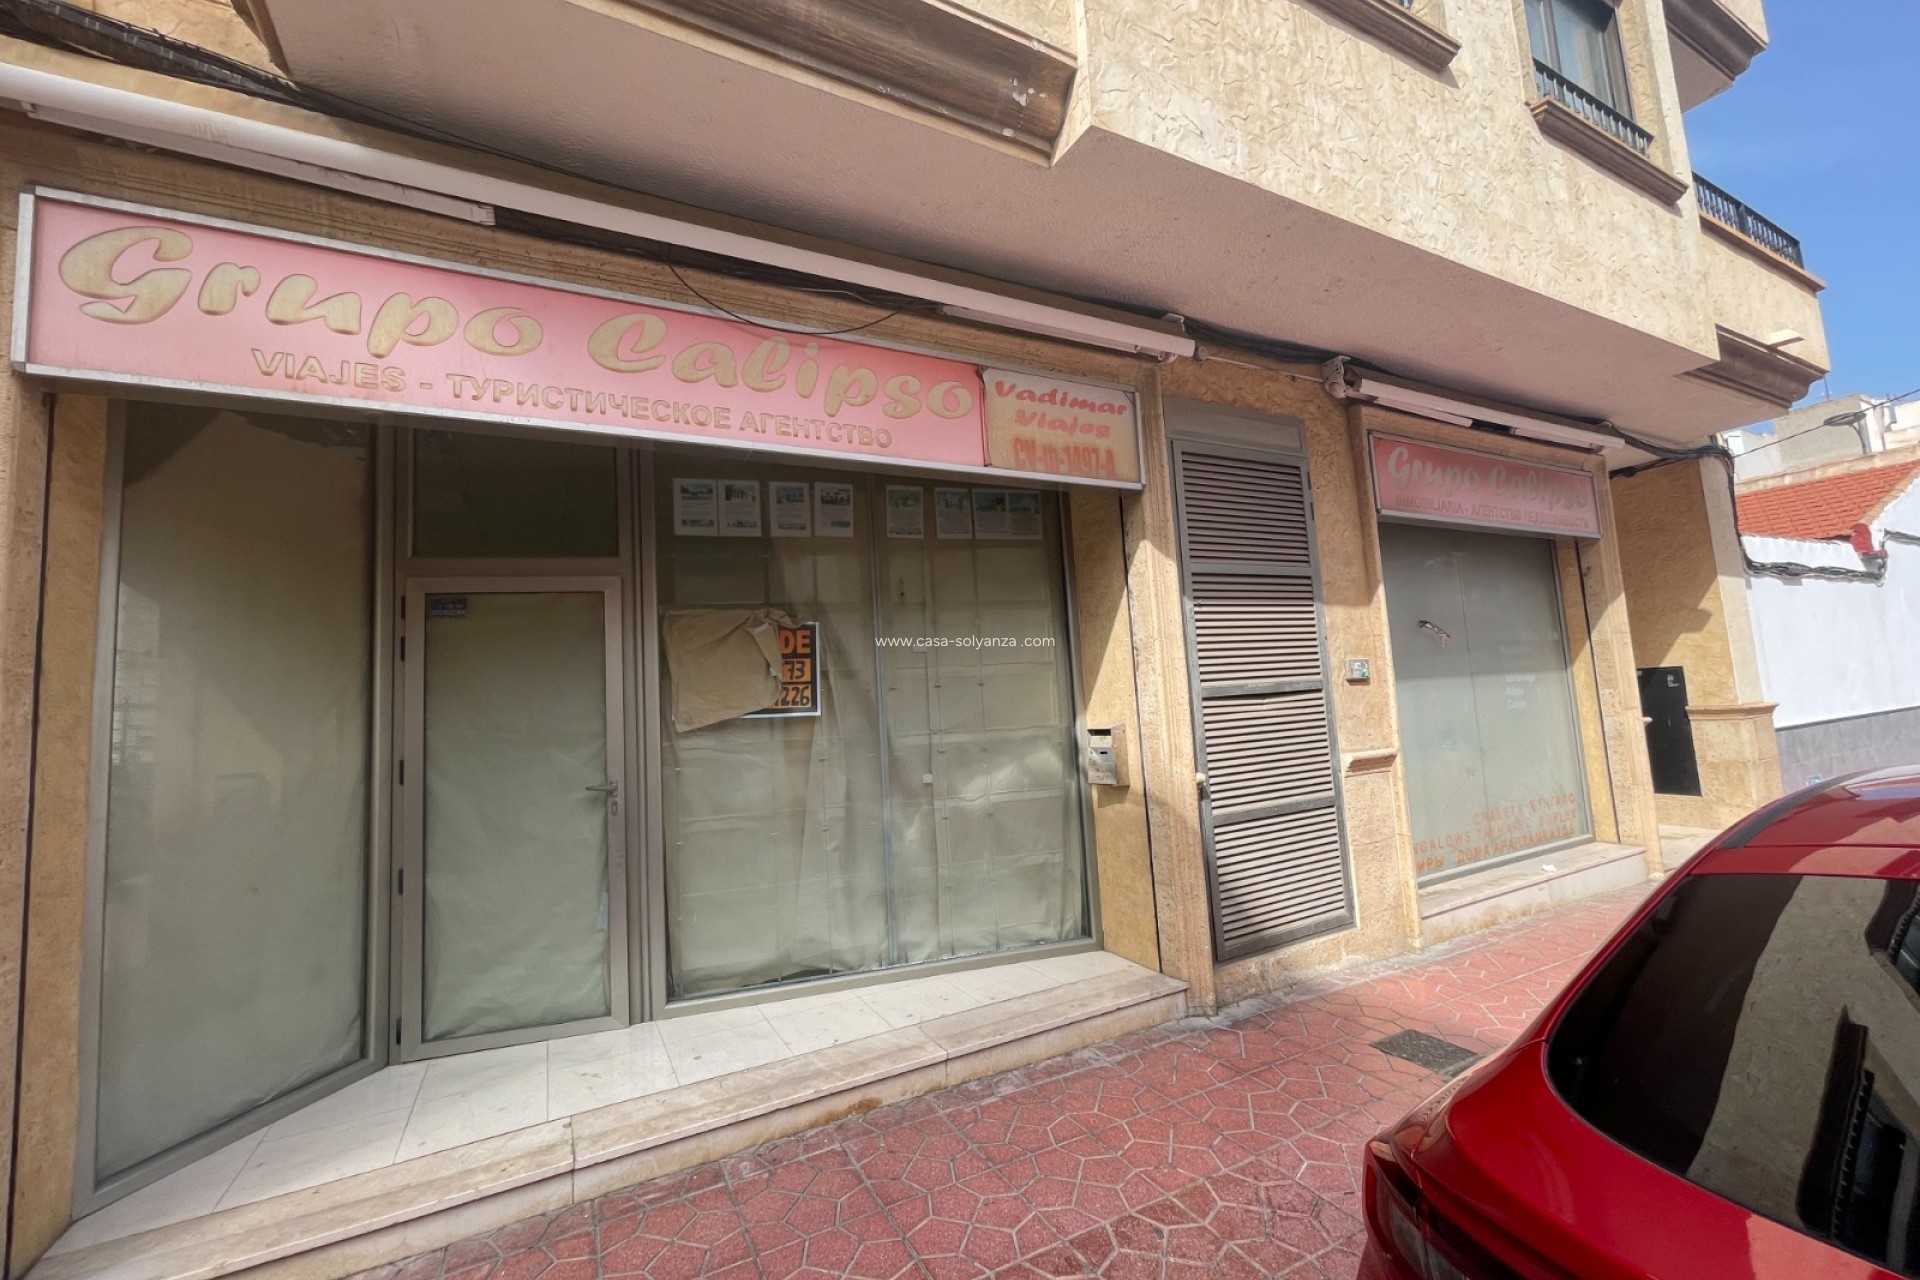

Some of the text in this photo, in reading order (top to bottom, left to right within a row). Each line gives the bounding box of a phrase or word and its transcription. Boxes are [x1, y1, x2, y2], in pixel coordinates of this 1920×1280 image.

[58, 225, 973, 420] Grupo Calipso
[251, 347, 407, 393] VIAJES
[445, 373, 731, 430] ТУРИСТИЧЕСКОЕ
[739, 410, 893, 450] АГЕНТСТВО
[994, 380, 1128, 416] Vadimar
[1387, 446, 1588, 512] Grupo Calipso
